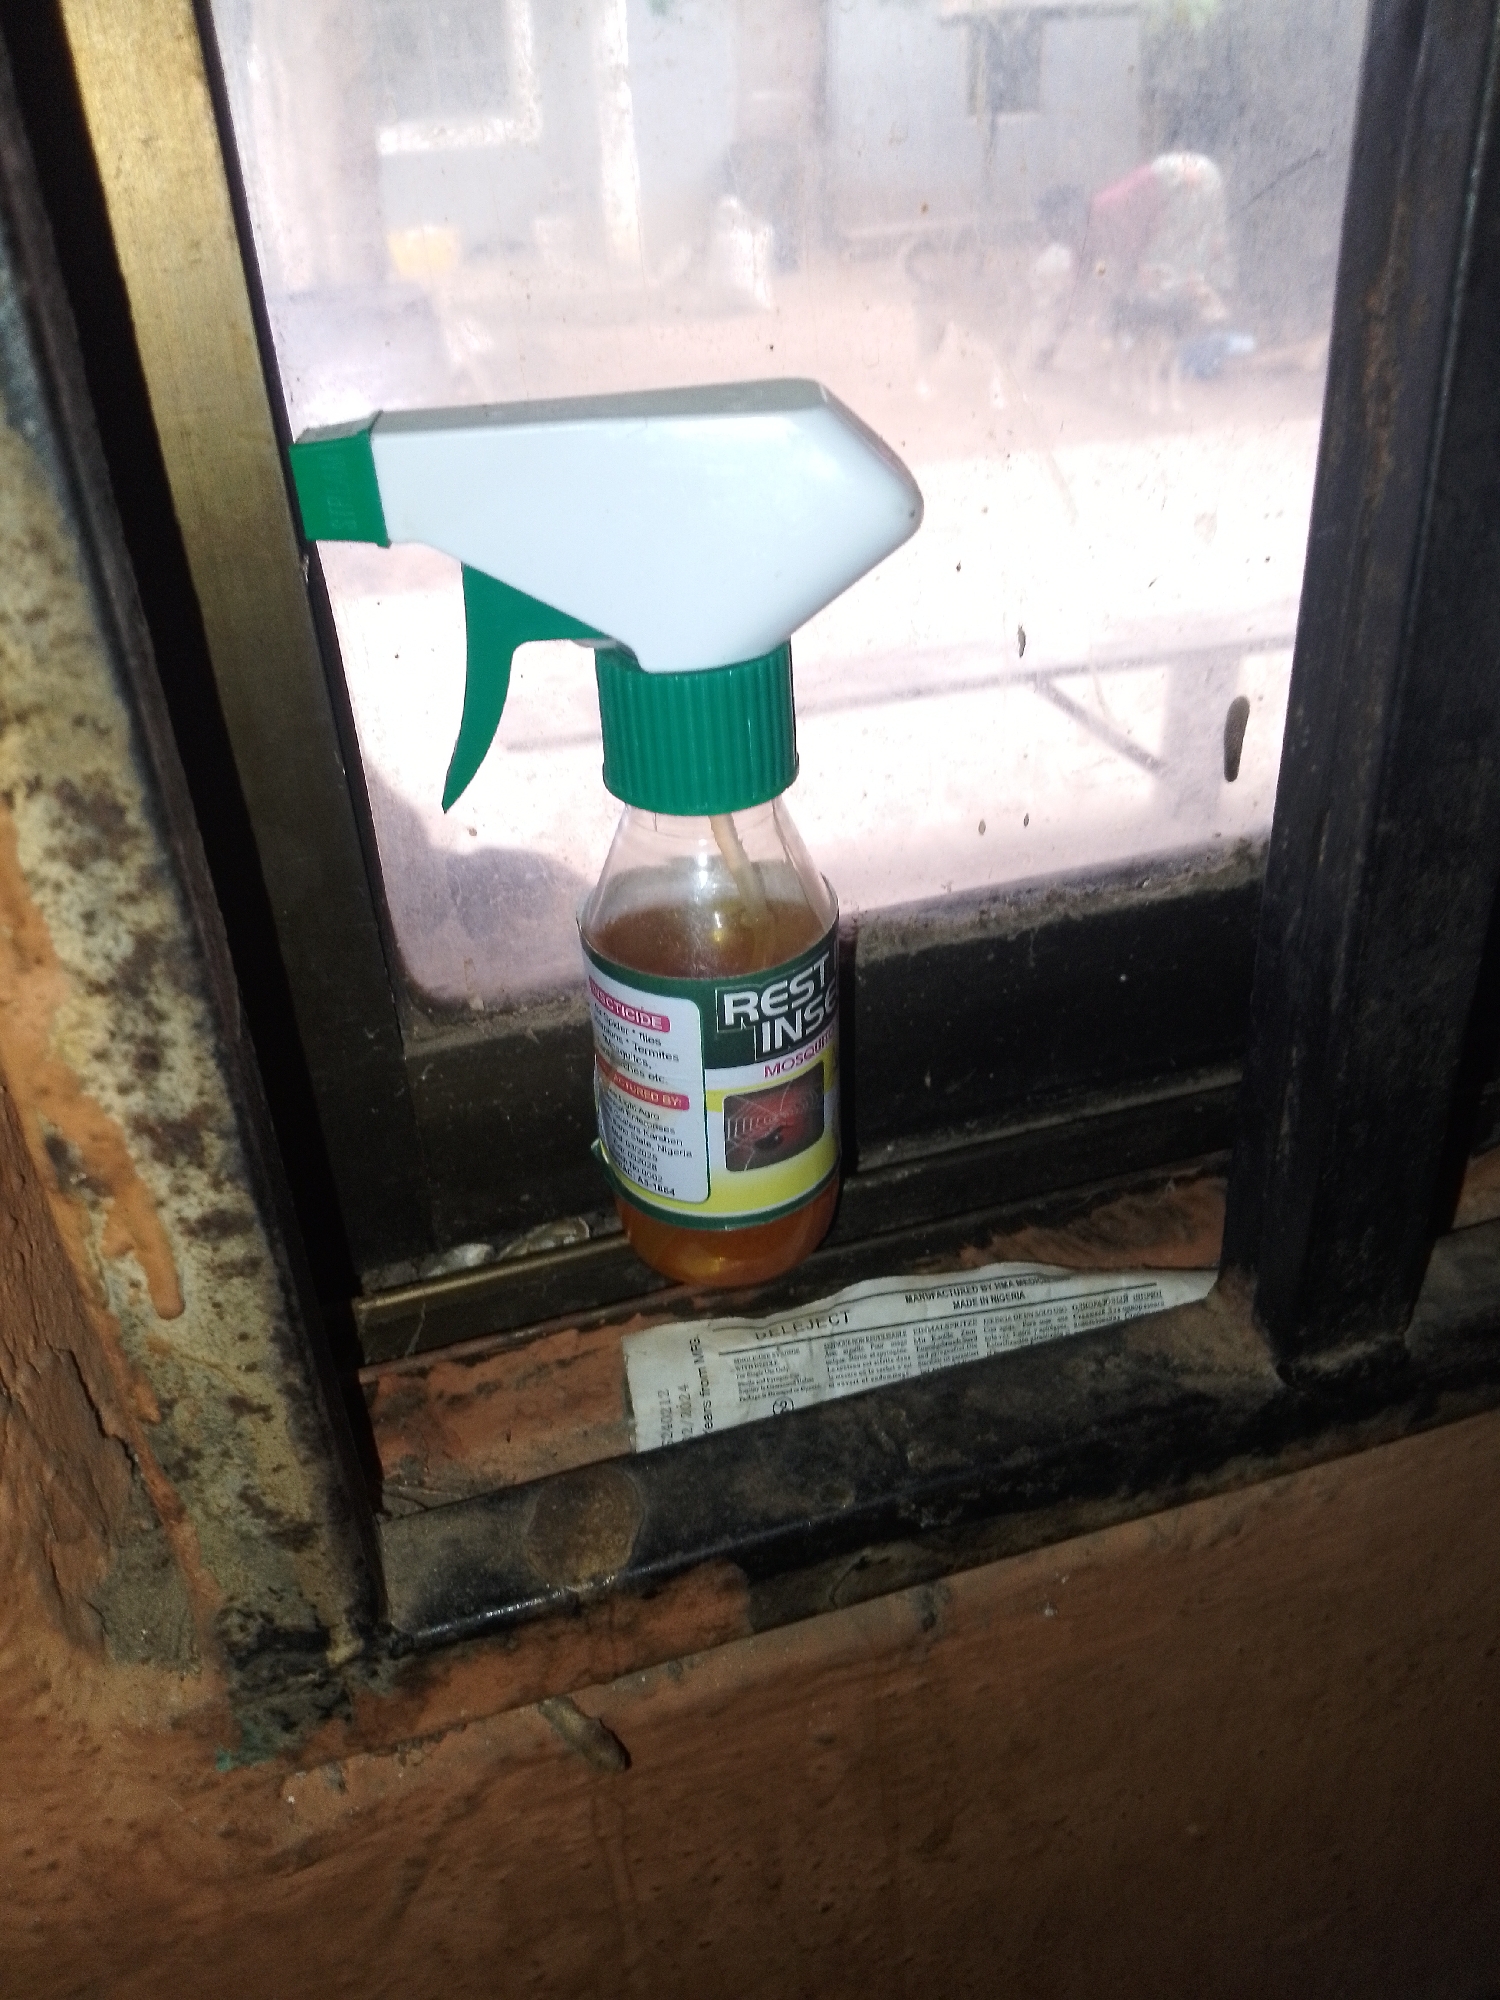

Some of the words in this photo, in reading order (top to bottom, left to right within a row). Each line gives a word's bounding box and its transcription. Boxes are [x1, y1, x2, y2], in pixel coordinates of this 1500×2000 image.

[723, 950, 830, 1027] REST
[631, 1039, 679, 1062] Termites
[656, 1142, 693, 1159] Nigeria
[904, 1284, 979, 1304] MANUFACTURED
[952, 1297, 979, 1310] MADE
[979, 1295, 990, 1306] IN
[990, 1290, 1026, 1305] NIGERIA
[676, 1383, 693, 1440] 2/2024
[702, 1400, 714, 1432] ears
